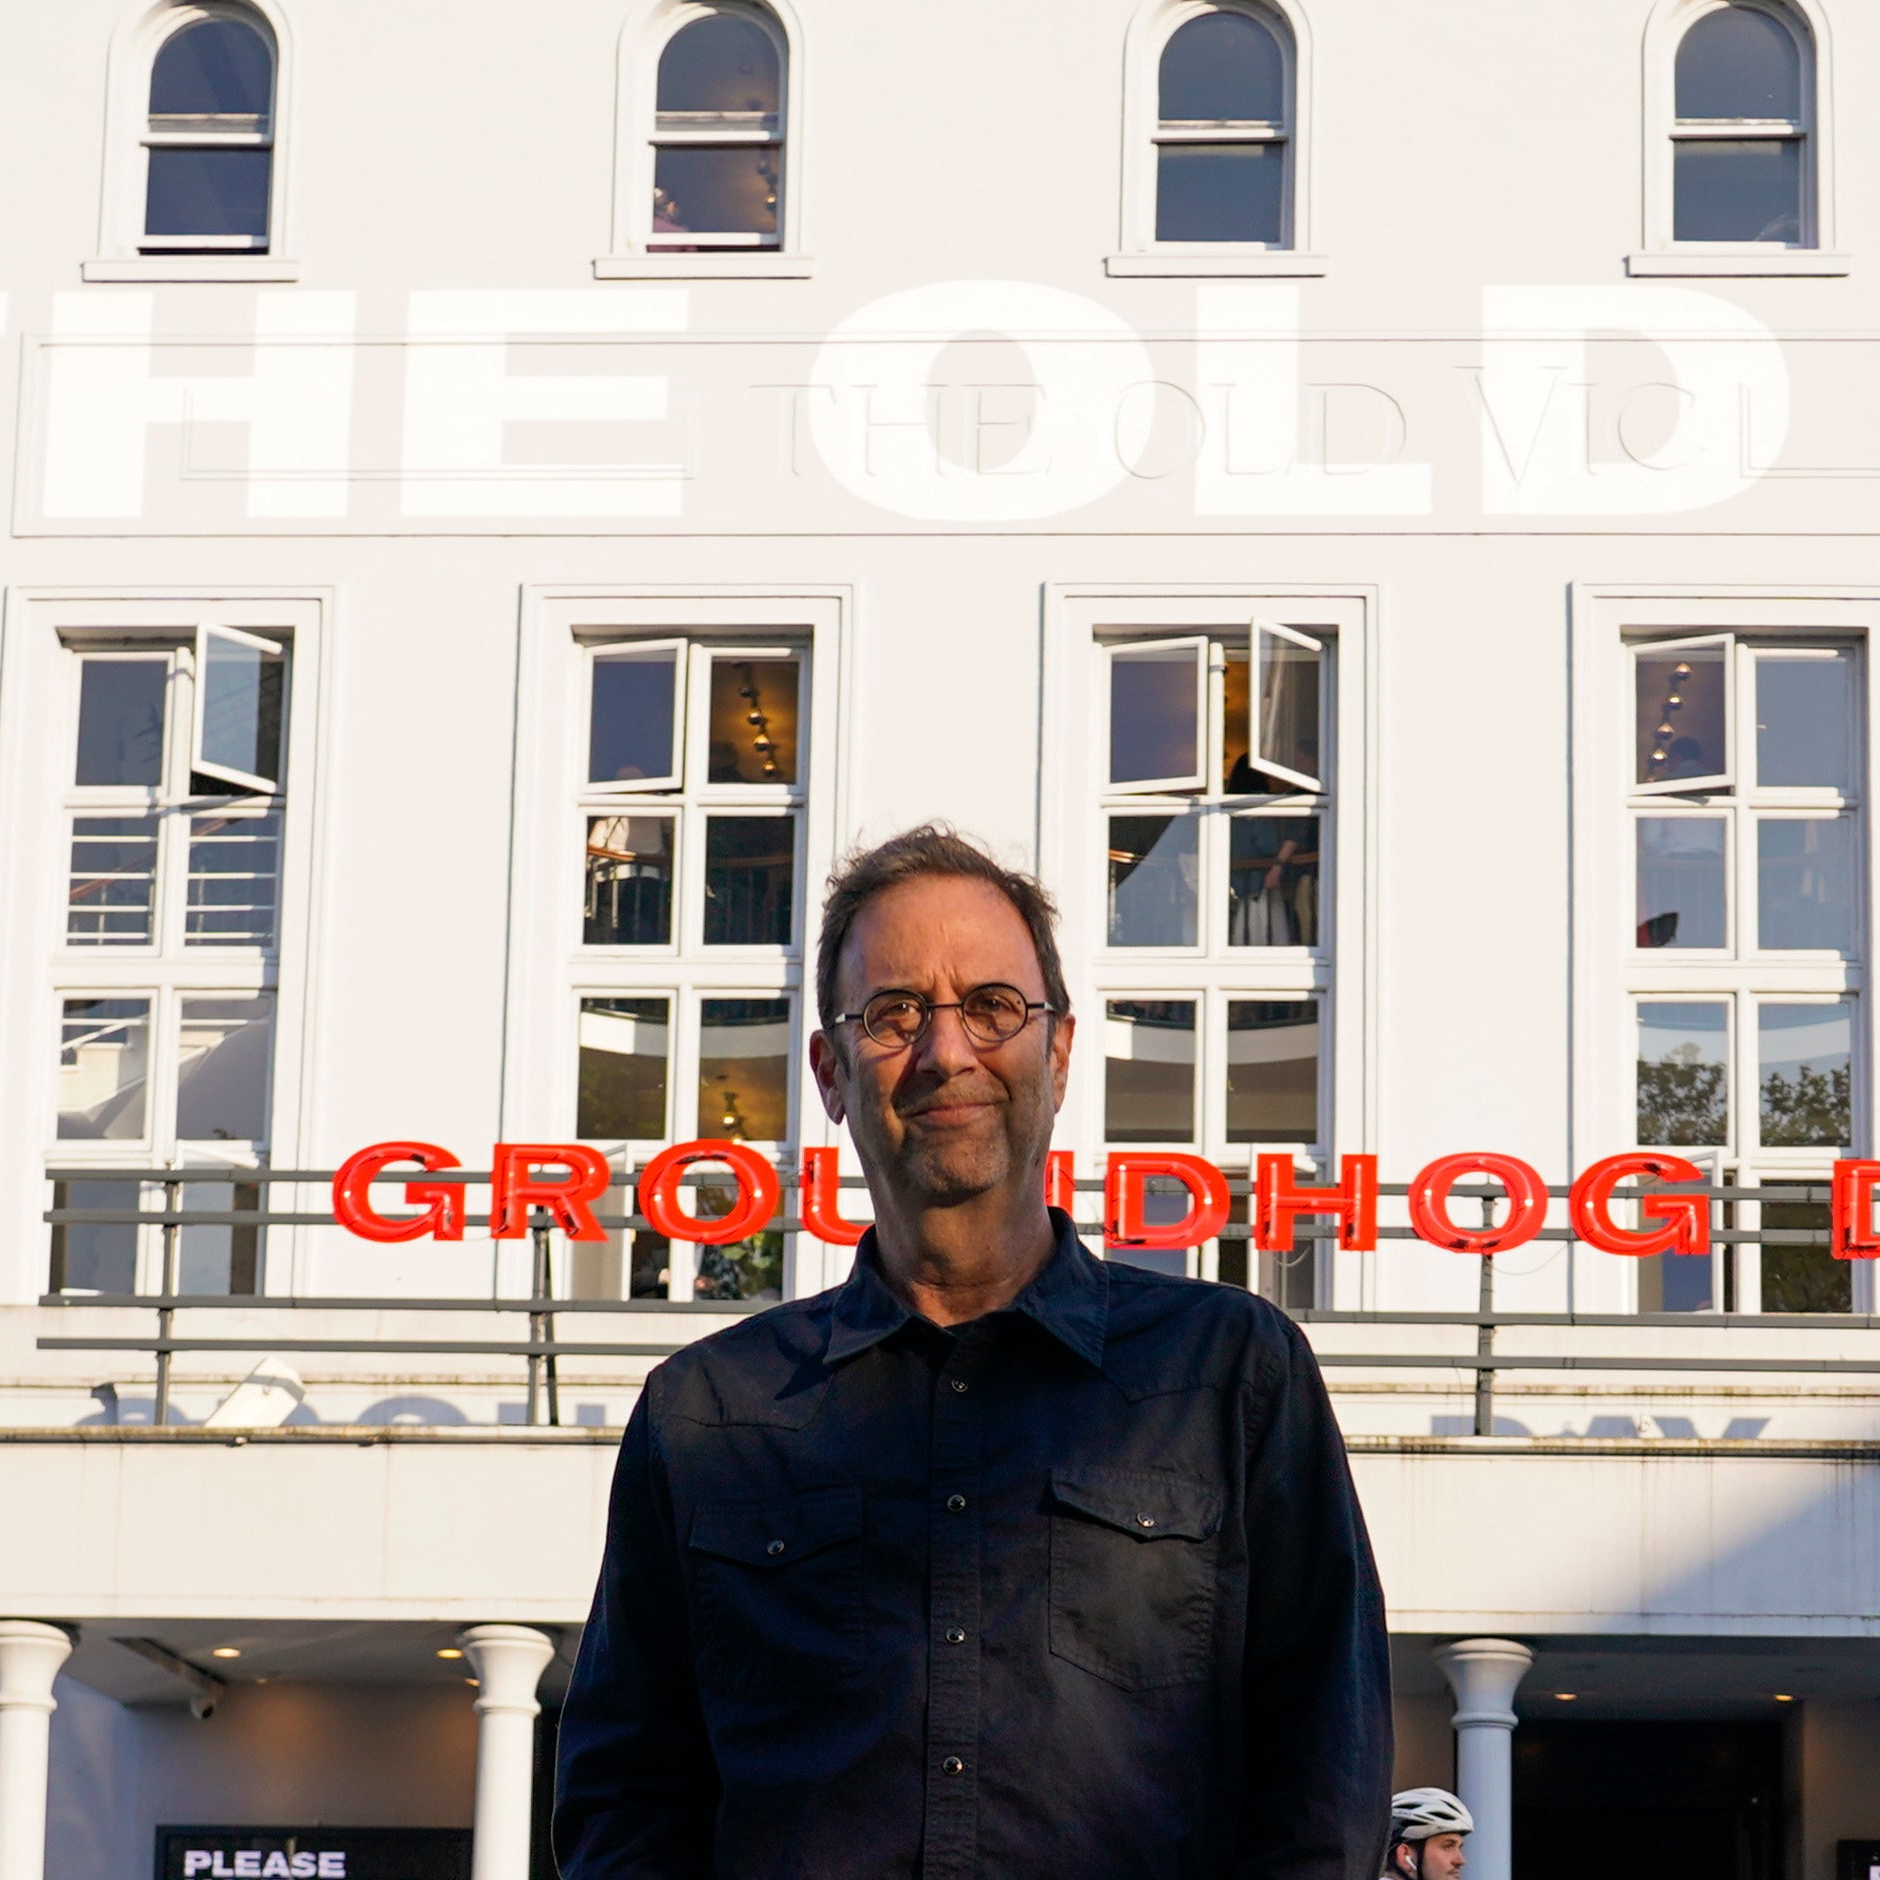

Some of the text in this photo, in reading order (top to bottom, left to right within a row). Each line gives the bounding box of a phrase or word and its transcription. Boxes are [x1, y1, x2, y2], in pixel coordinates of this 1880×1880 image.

[808, 279, 1791, 522] OLD
[331, 1139, 1711, 1257] GROUDHOG
[184, 1849, 347, 1879] PLEASE
